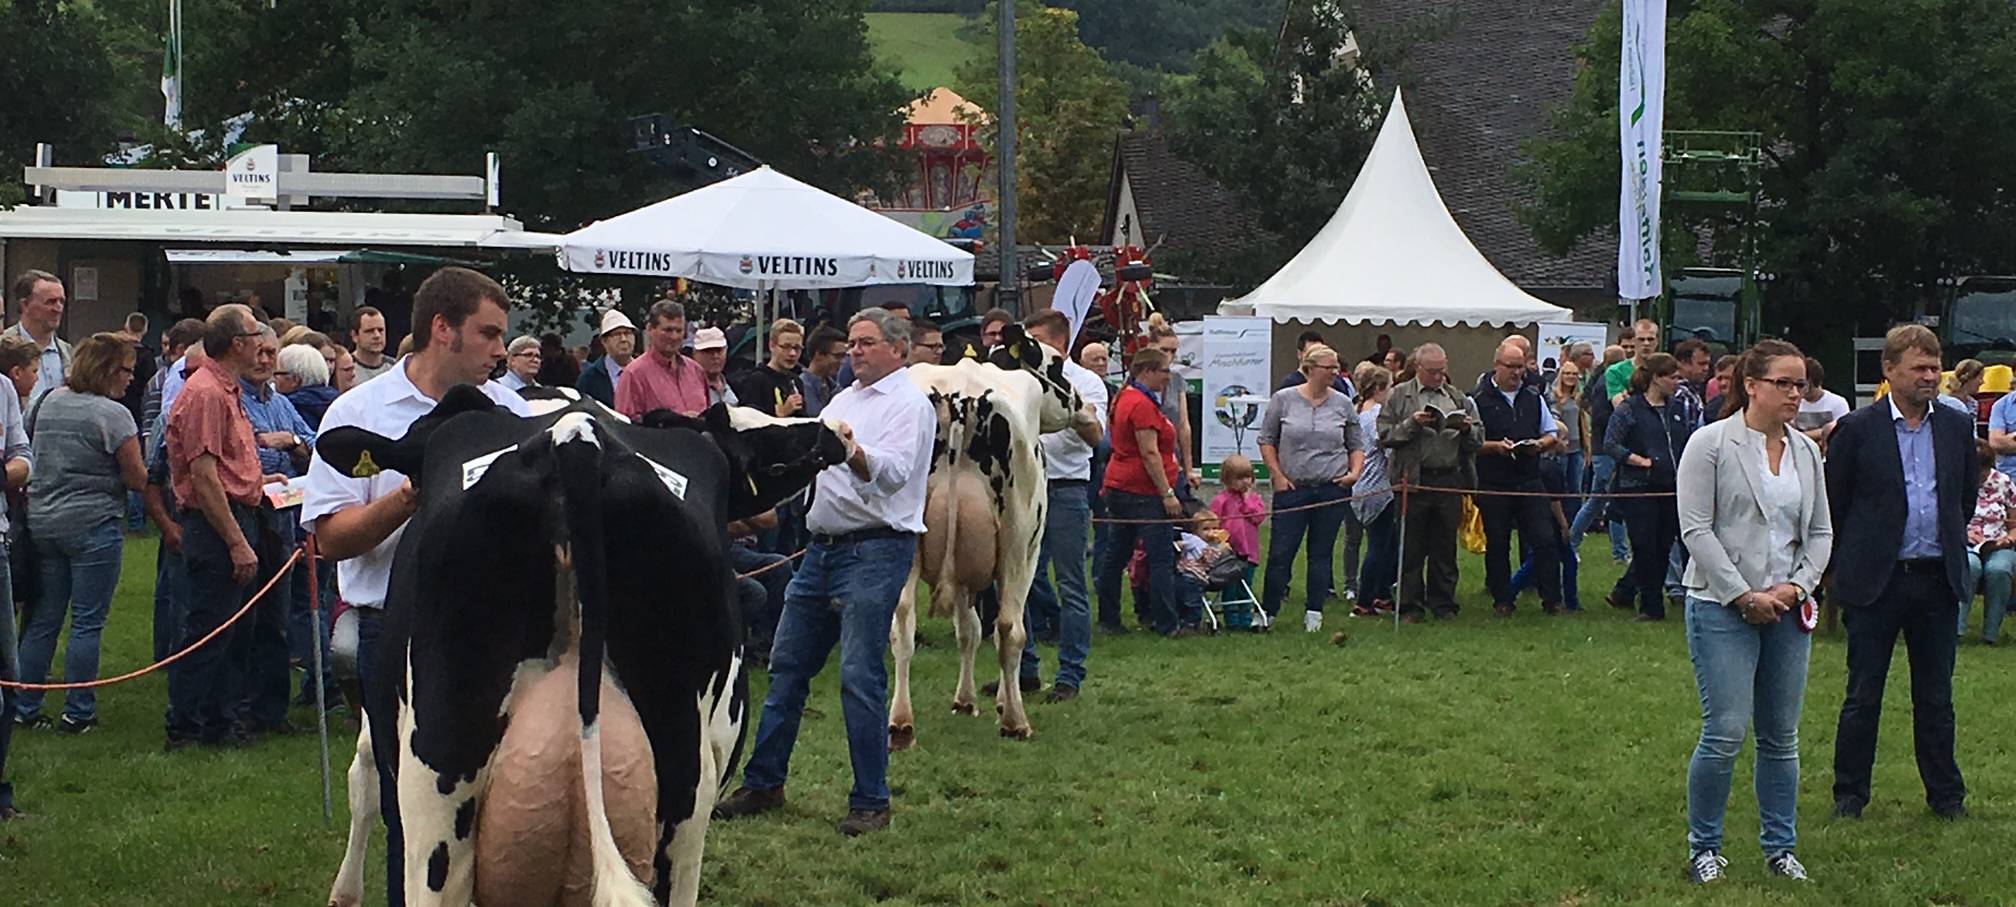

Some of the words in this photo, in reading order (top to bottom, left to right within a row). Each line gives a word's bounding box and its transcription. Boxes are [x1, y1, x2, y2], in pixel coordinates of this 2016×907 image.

[233, 174, 271, 183] VELTINS
[608, 250, 671, 271] VELTINS
[758, 256, 838, 276] VELTINS
[908, 260, 954, 279] VELTINS
